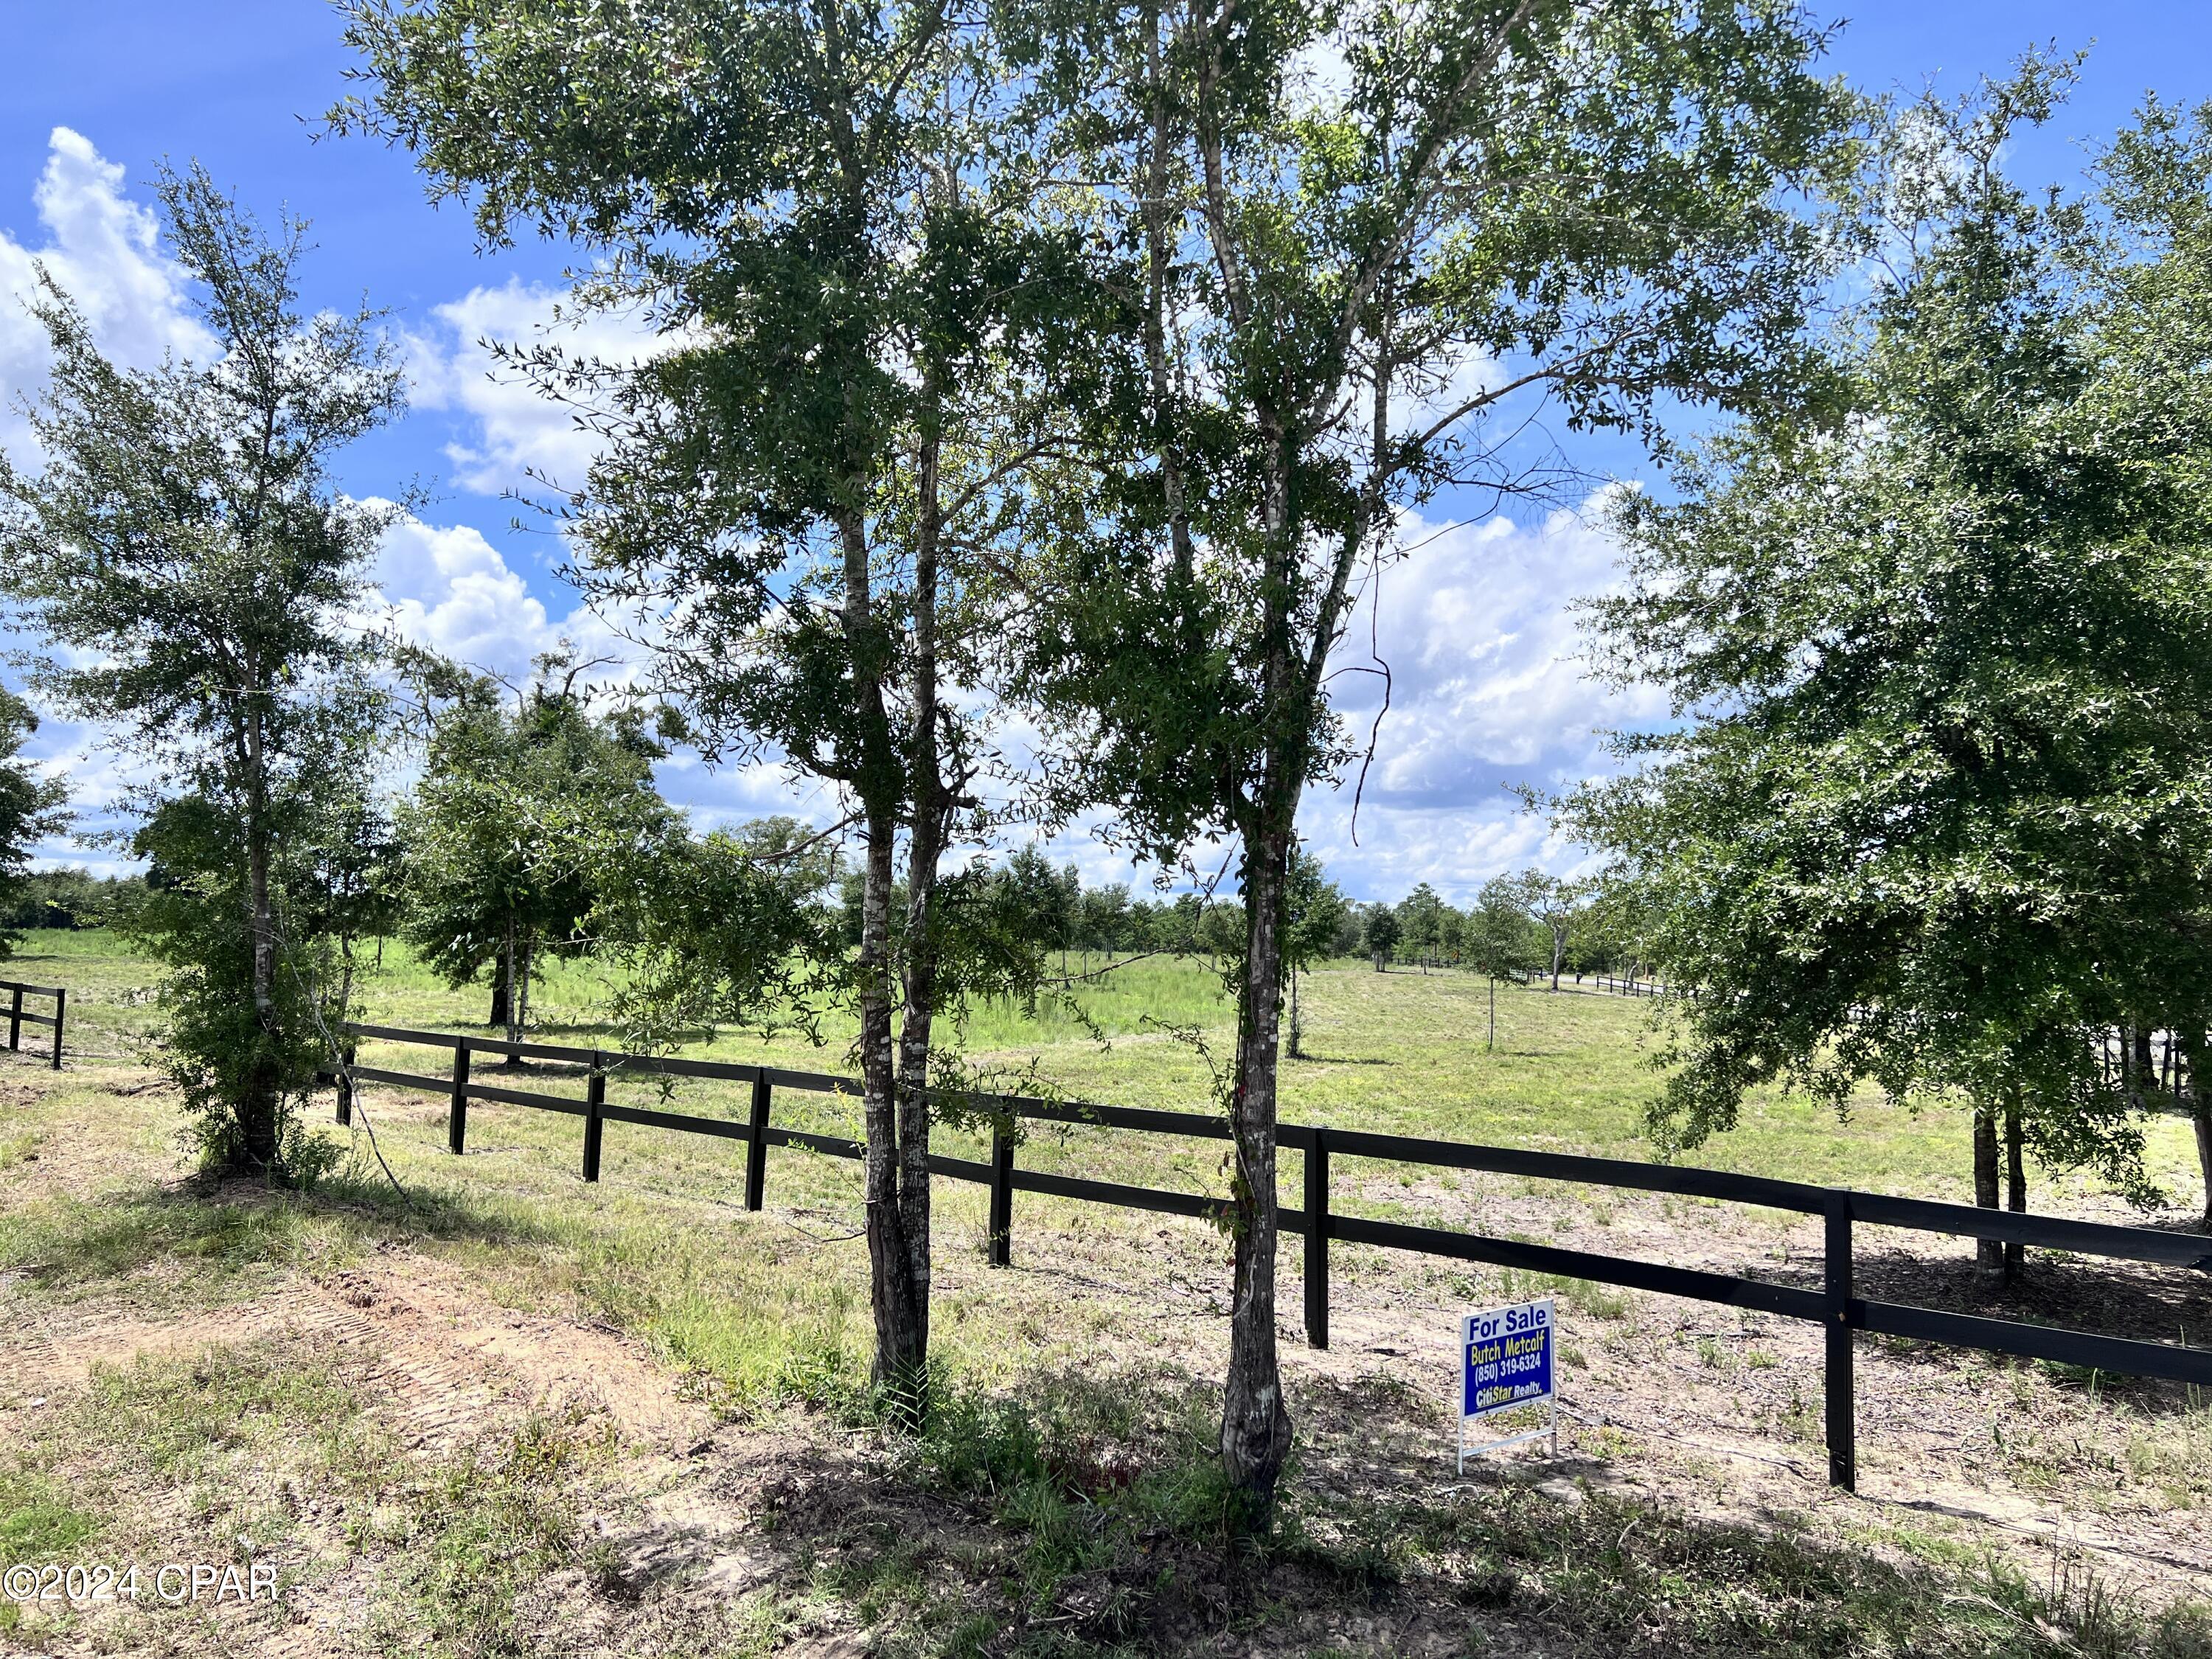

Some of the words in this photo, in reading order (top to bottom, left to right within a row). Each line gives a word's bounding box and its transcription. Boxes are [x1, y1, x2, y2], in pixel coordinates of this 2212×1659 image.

[1470, 1317, 1500, 1340] For
[1506, 1306, 1546, 1332] Sale
[1471, 1340, 1500, 1366] Butch
[1505, 1329, 1545, 1358] Metcalf
[1475, 1363, 1498, 1387] (850)
[1500, 1352, 1541, 1377] 319-6324
[1475, 1385, 1512, 1407] CitiStar
